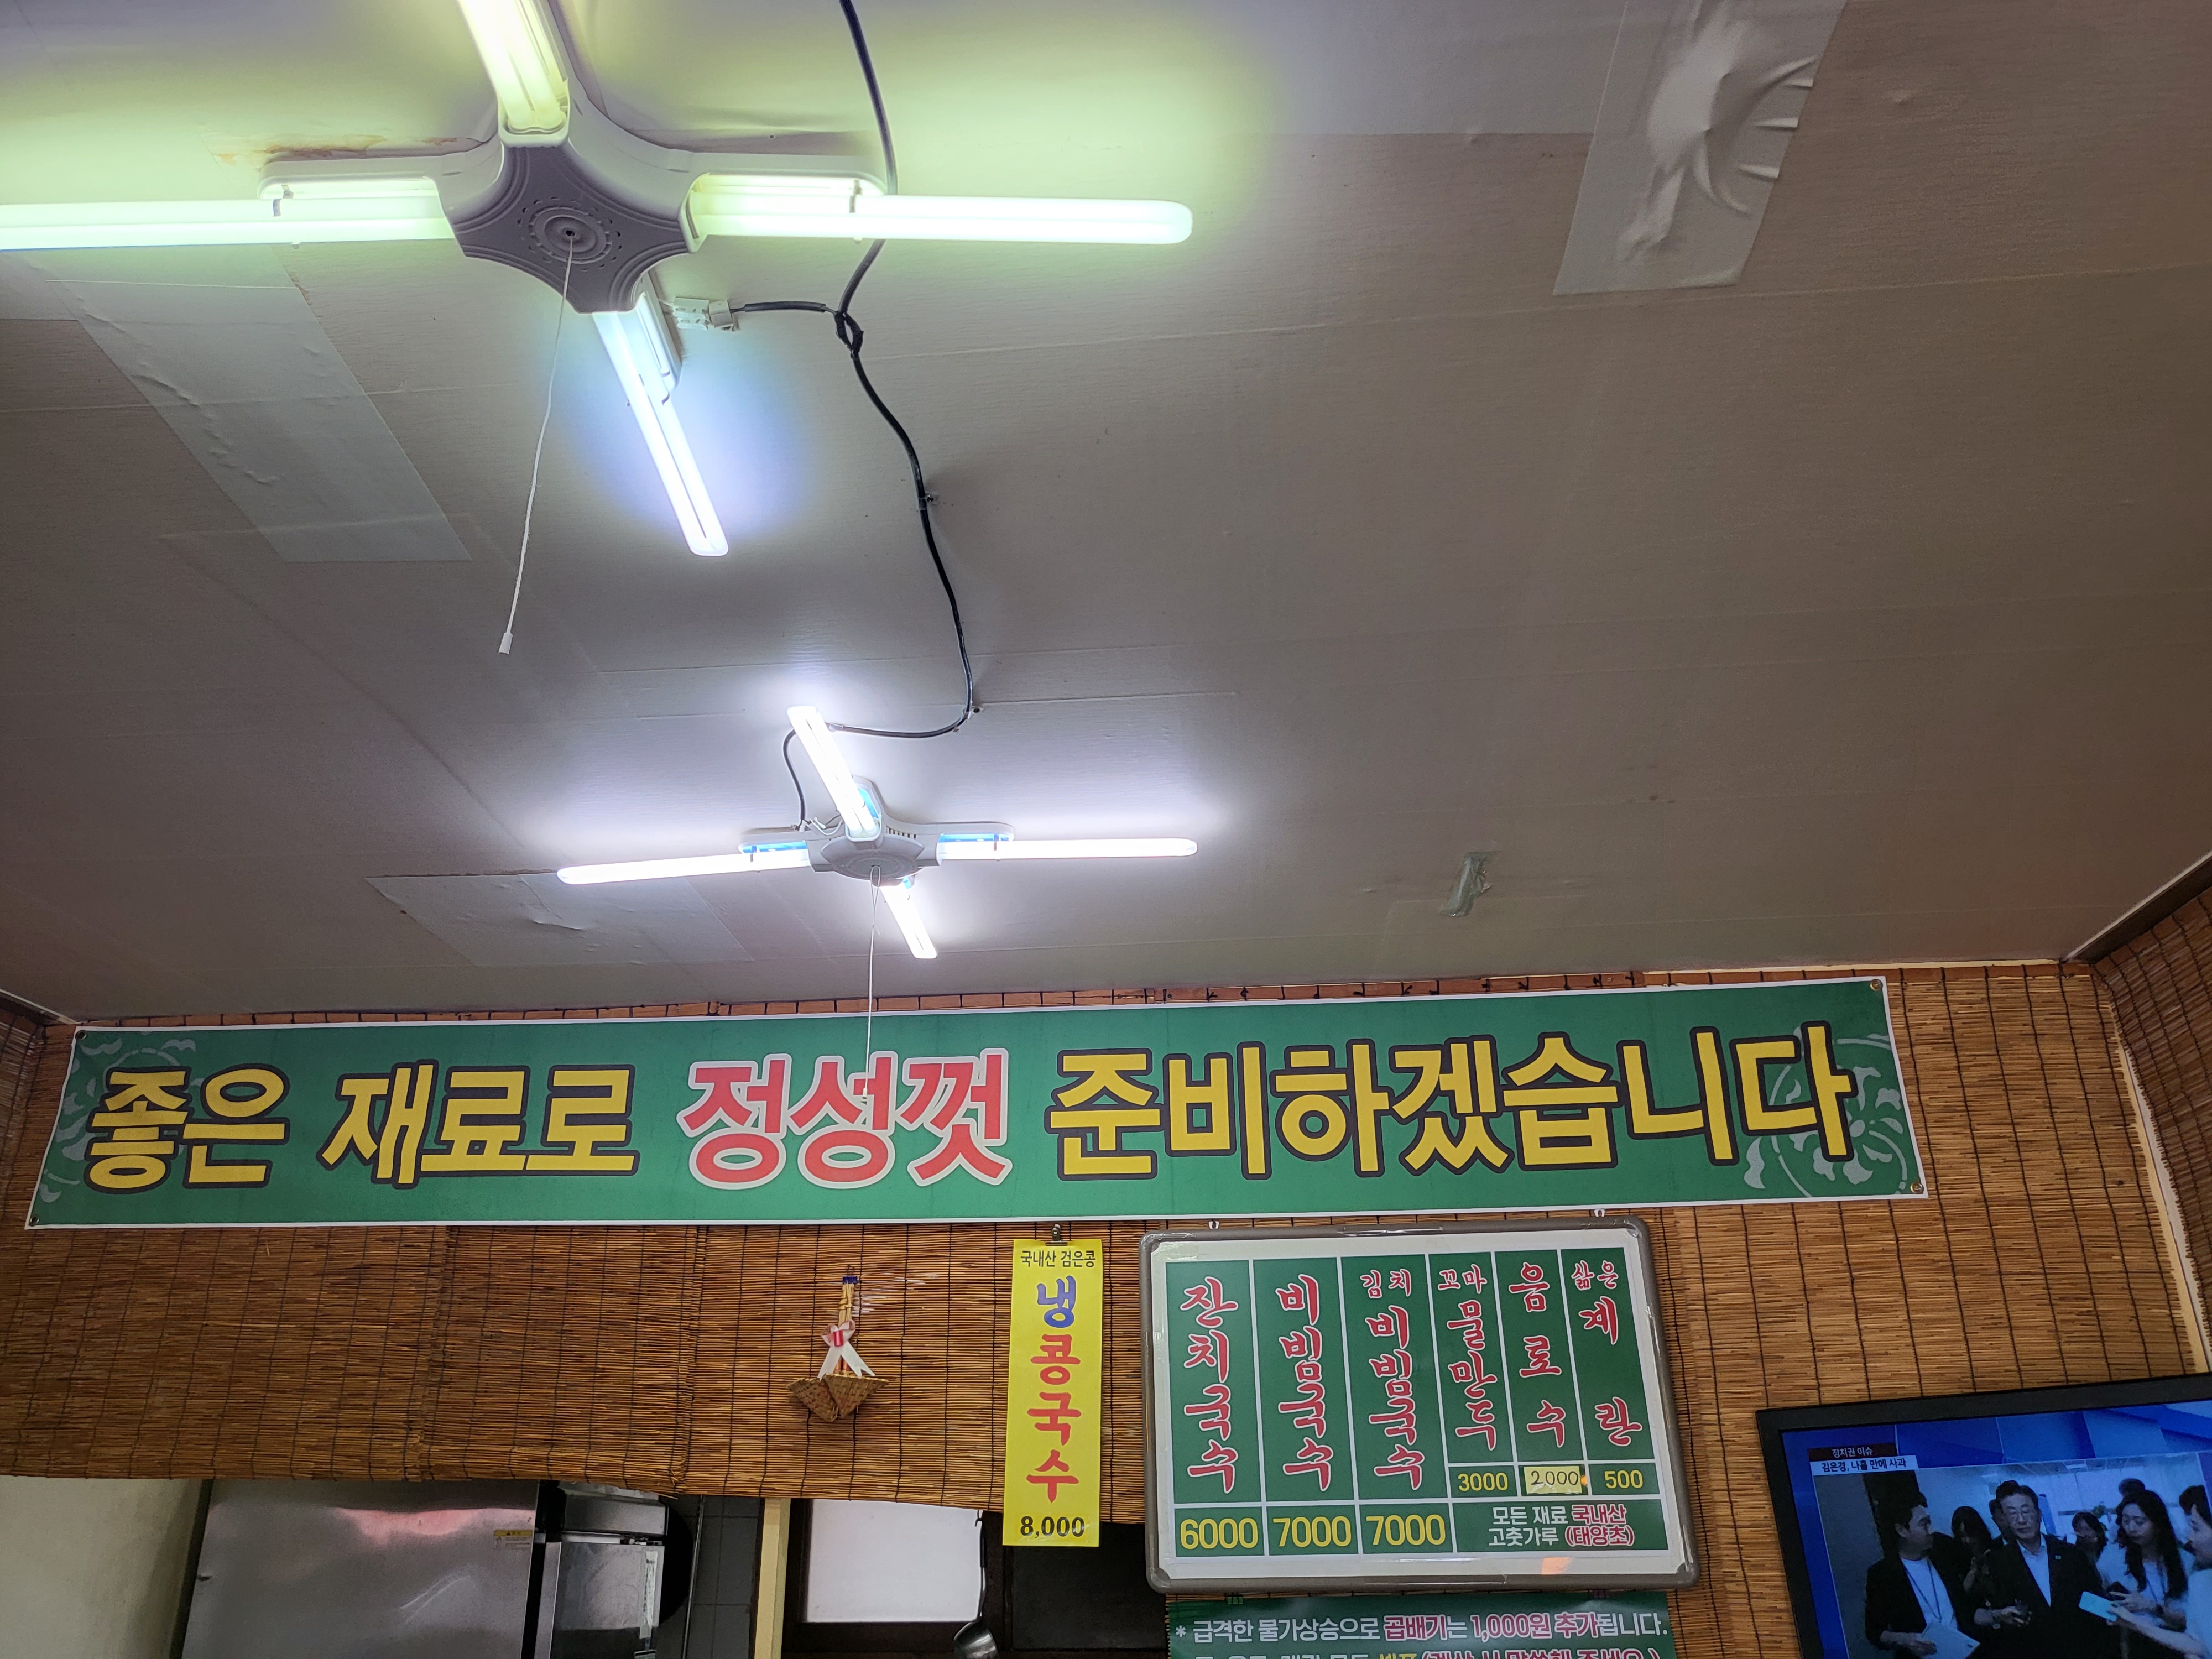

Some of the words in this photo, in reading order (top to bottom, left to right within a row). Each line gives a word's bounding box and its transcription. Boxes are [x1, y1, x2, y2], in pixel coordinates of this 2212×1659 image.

[85, 1063, 288, 1194] 좋은
[317, 1059, 639, 1189] 재료로
[677, 1048, 1012, 1190] 정성껏
[1045, 1021, 1858, 1180] 준비하겠습니다
[1020, 1250, 1056, 1268] 국내산
[1061, 1250, 1095, 1267] 검은콩
[1360, 1269, 1411, 1298] 김치
[1437, 1264, 1487, 1293] 꼬마
[1571, 1260, 1618, 1290] 삶은
[1180, 1276, 1239, 1494] 잔치국수
[1275, 1274, 1332, 1491] 비빔국수
[1447, 1300, 1498, 1451] 물만두
[1365, 1305, 1424, 1491] 비빔국수
[1831, 1447, 1855, 1458] 정치권
[1856, 1446, 1874, 1456] 이슈
[1870, 1458, 1887, 1470] 만에
[1889, 1457, 1907, 1468] 사과
[1457, 1472, 1509, 1492] 3000
[1604, 1469, 1644, 1489] 500
[1020, 1516, 1085, 1539] 8,000
[1493, 1506, 1527, 1525] 모든
[1532, 1505, 1568, 1525] 재료
[1571, 1504, 1627, 1525] 국내산
[1180, 1517, 1258, 1551] 6000
[1272, 1515, 1352, 1549] 7000
[1366, 1513, 1446, 1547] 7000
[1488, 1527, 1559, 1547] 고춧가루
[1564, 1525, 1635, 1547] (태양초)
[1193, 1619, 1254, 1643] 급격한
[1258, 1617, 1381, 1642] 물가상승으로
[1383, 1614, 1467, 1641] 곱배기는
[1470, 1612, 1552, 1642] 1,000원
[1554, 1611, 1667, 1639] 추가됩니다.
